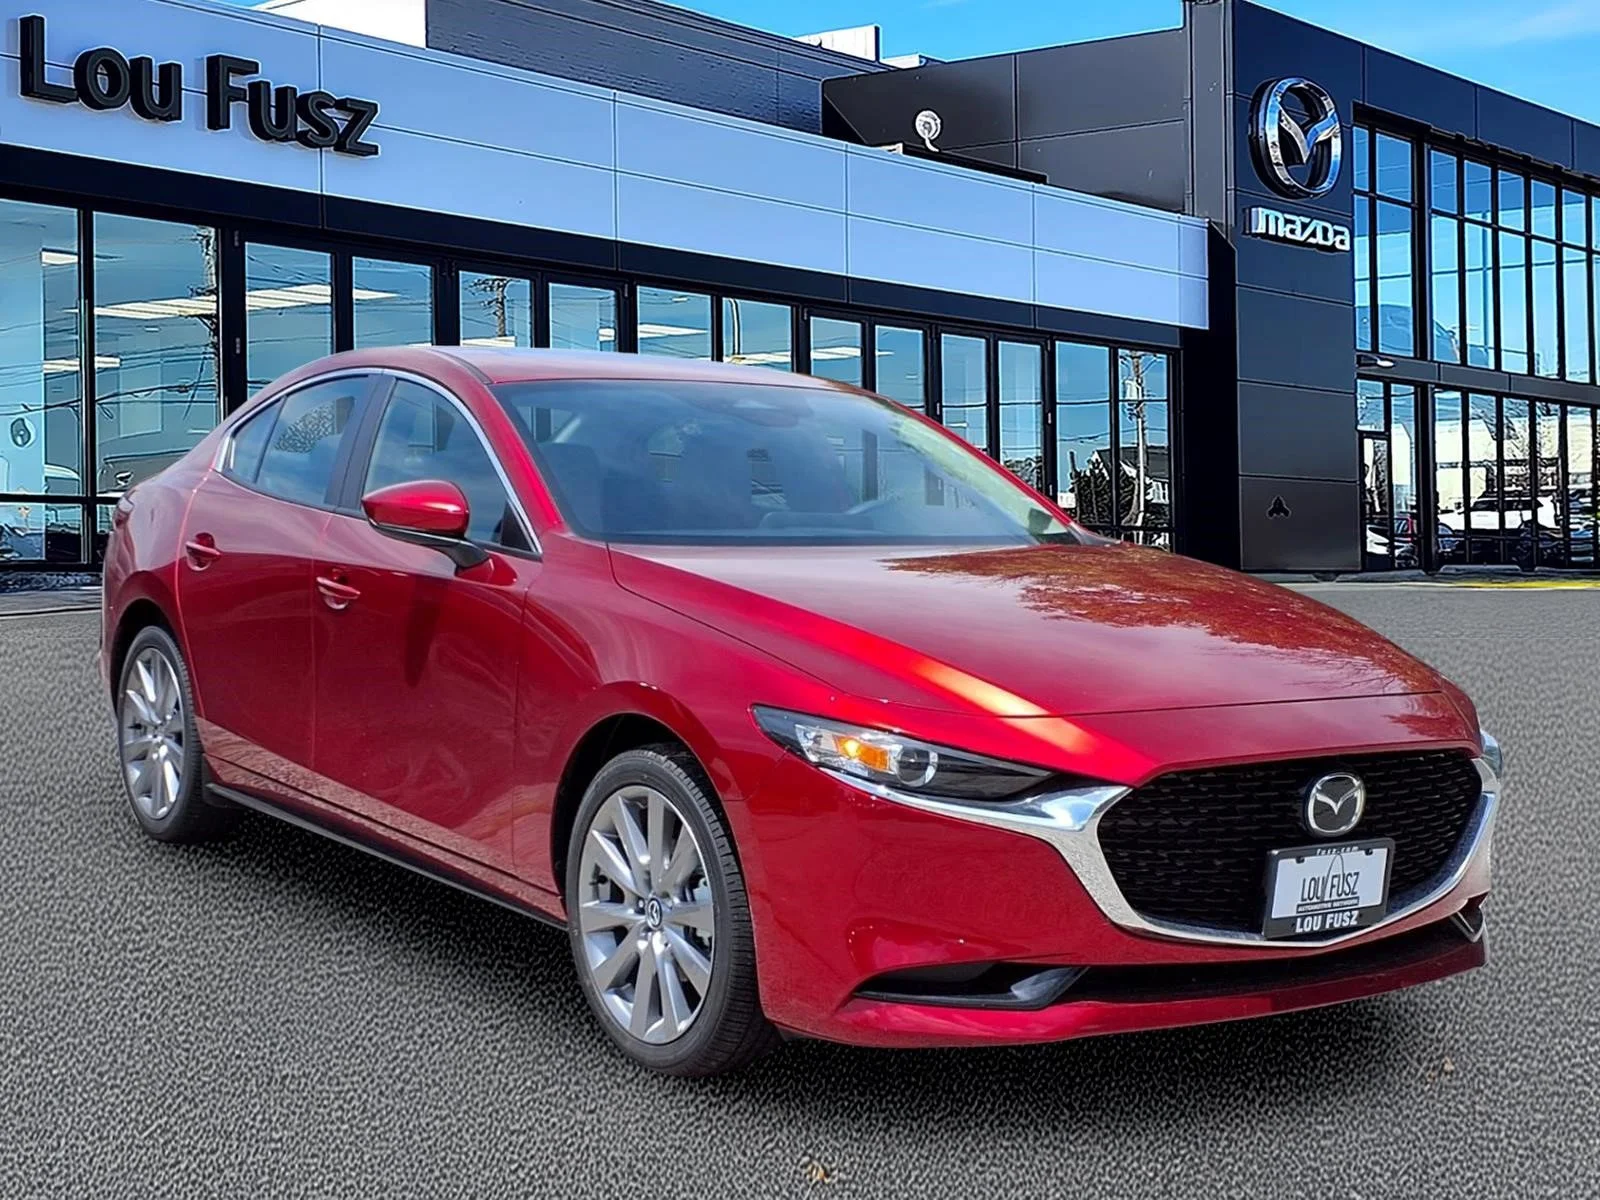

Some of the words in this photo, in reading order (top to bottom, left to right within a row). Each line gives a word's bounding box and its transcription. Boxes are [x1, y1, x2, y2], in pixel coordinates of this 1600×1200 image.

[19, 14, 182, 122] Lou
[206, 54, 380, 156] Fusz
[1301, 876, 1325, 901] LOU
[1329, 872, 1360, 898] FUSZ
[1295, 914, 1322, 933] LOU
[1325, 911, 1359, 928] FUSZ
